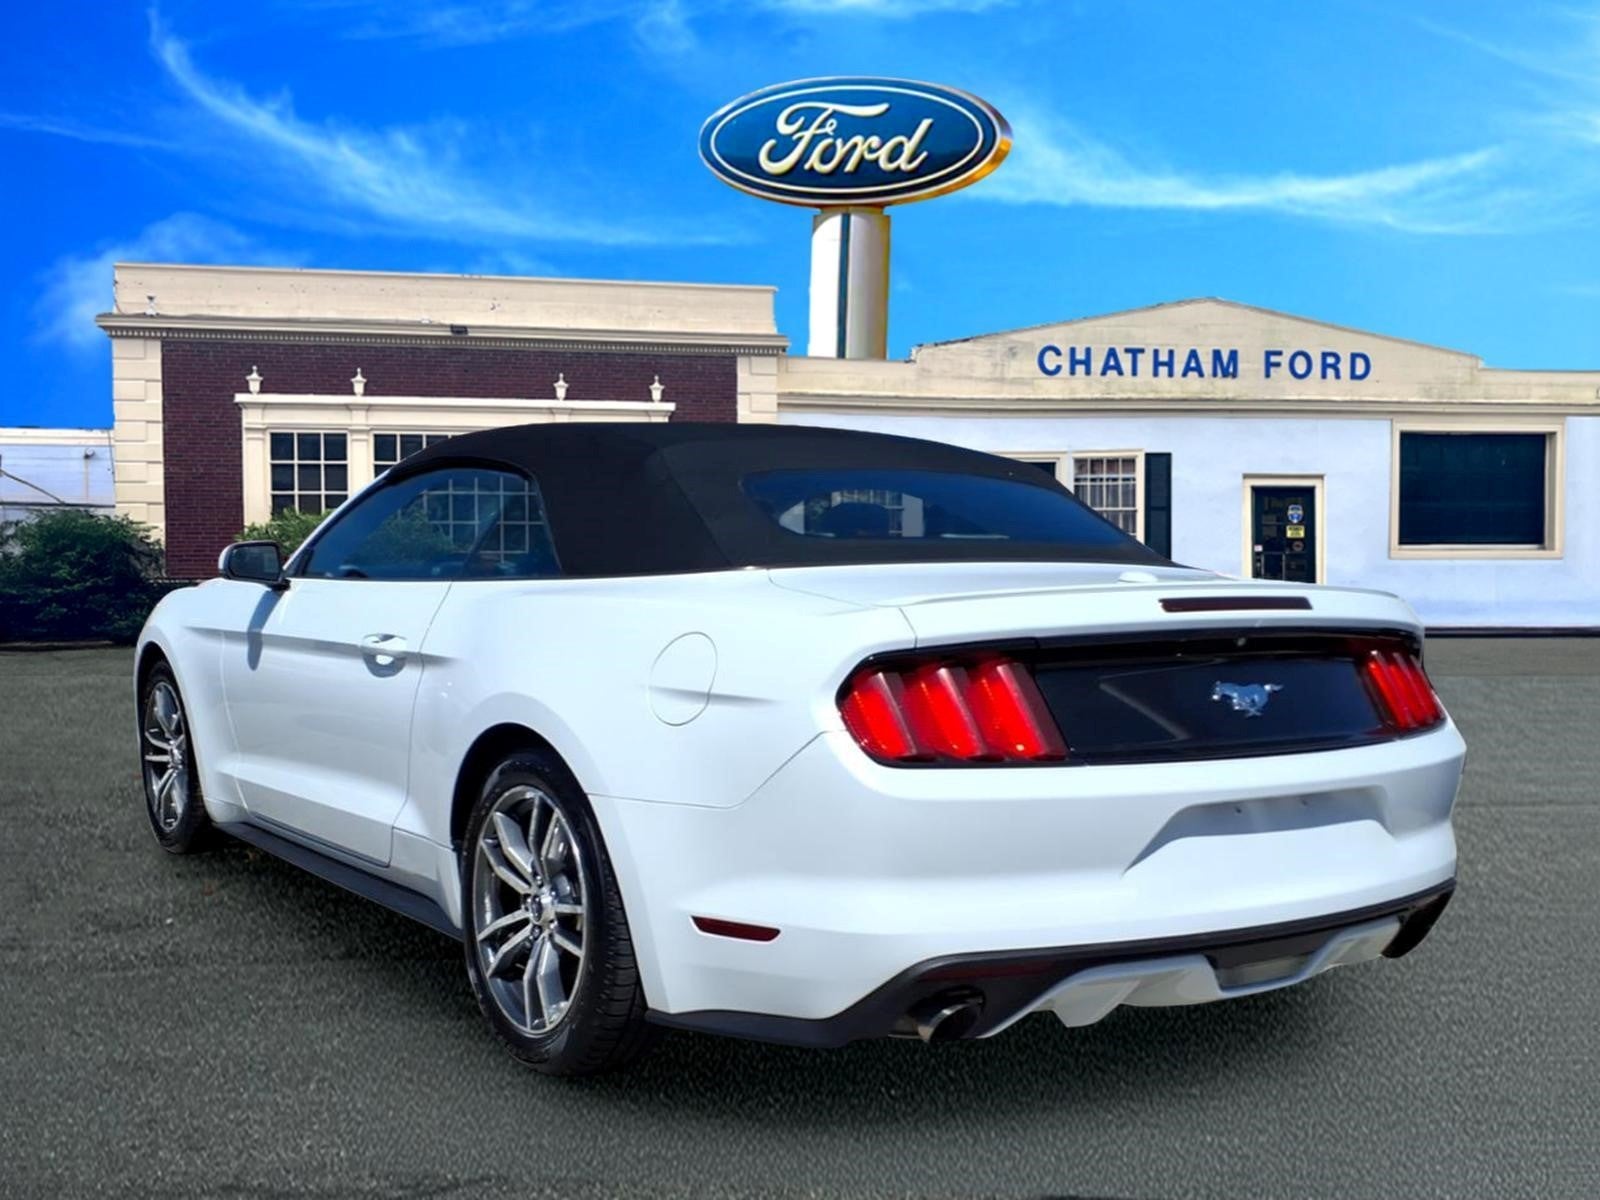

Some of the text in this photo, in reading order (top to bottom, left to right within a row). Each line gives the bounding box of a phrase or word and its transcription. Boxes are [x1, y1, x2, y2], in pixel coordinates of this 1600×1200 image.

[758, 101, 934, 176] Ford
[1037, 345, 1372, 381] CHATHAM FORD
